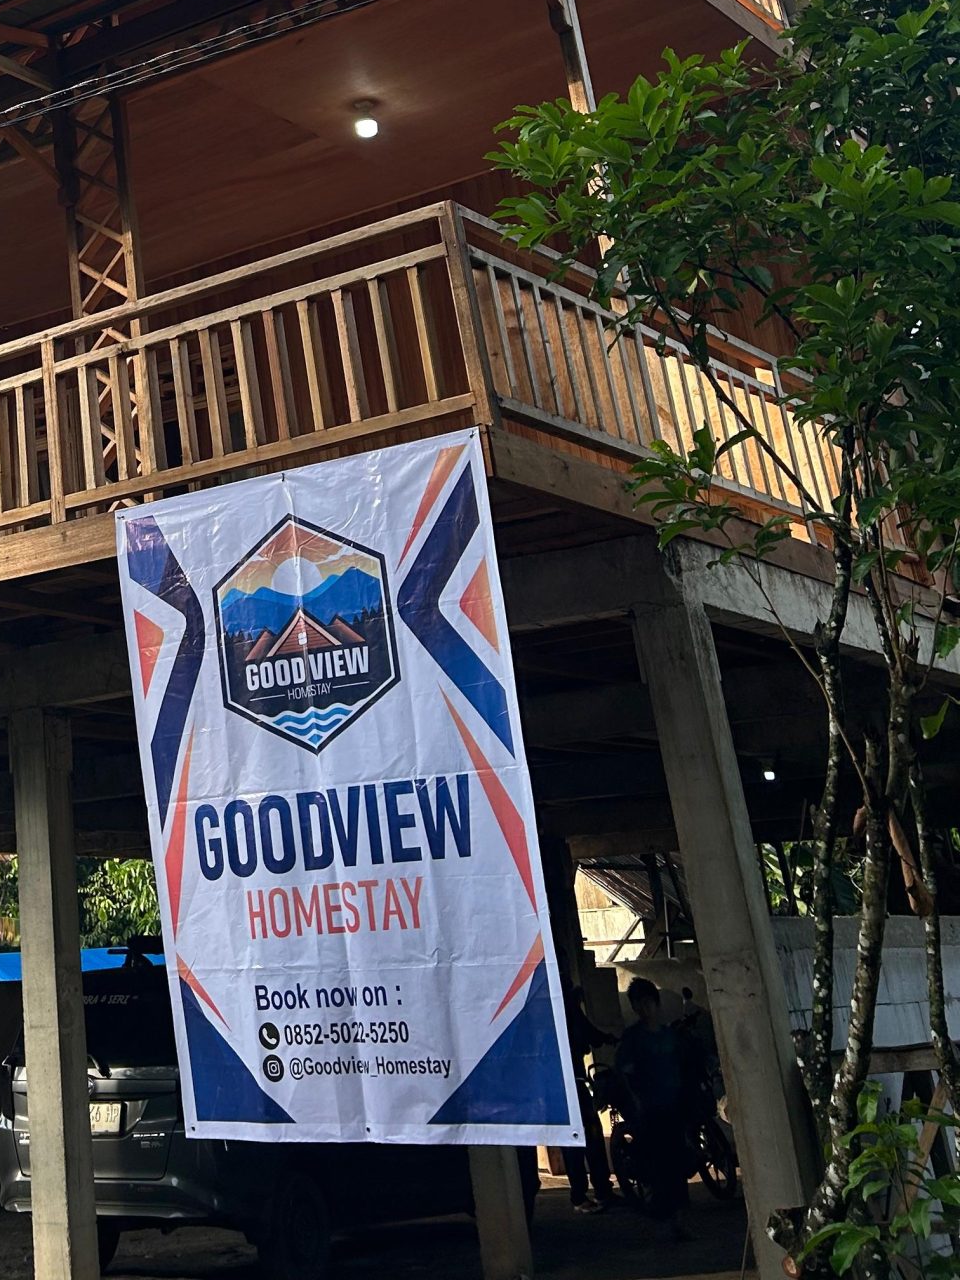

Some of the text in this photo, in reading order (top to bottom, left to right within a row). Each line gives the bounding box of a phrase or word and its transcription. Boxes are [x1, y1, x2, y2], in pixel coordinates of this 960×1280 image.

[194, 773, 471, 881] GOODVIEW
[246, 877, 423, 940] HOMESTAY
[254, 983, 310, 1011] Book
[315, 986, 358, 1009] now
[362, 985, 388, 1007] on
[283, 1021, 410, 1046] 0852-5022-5250
